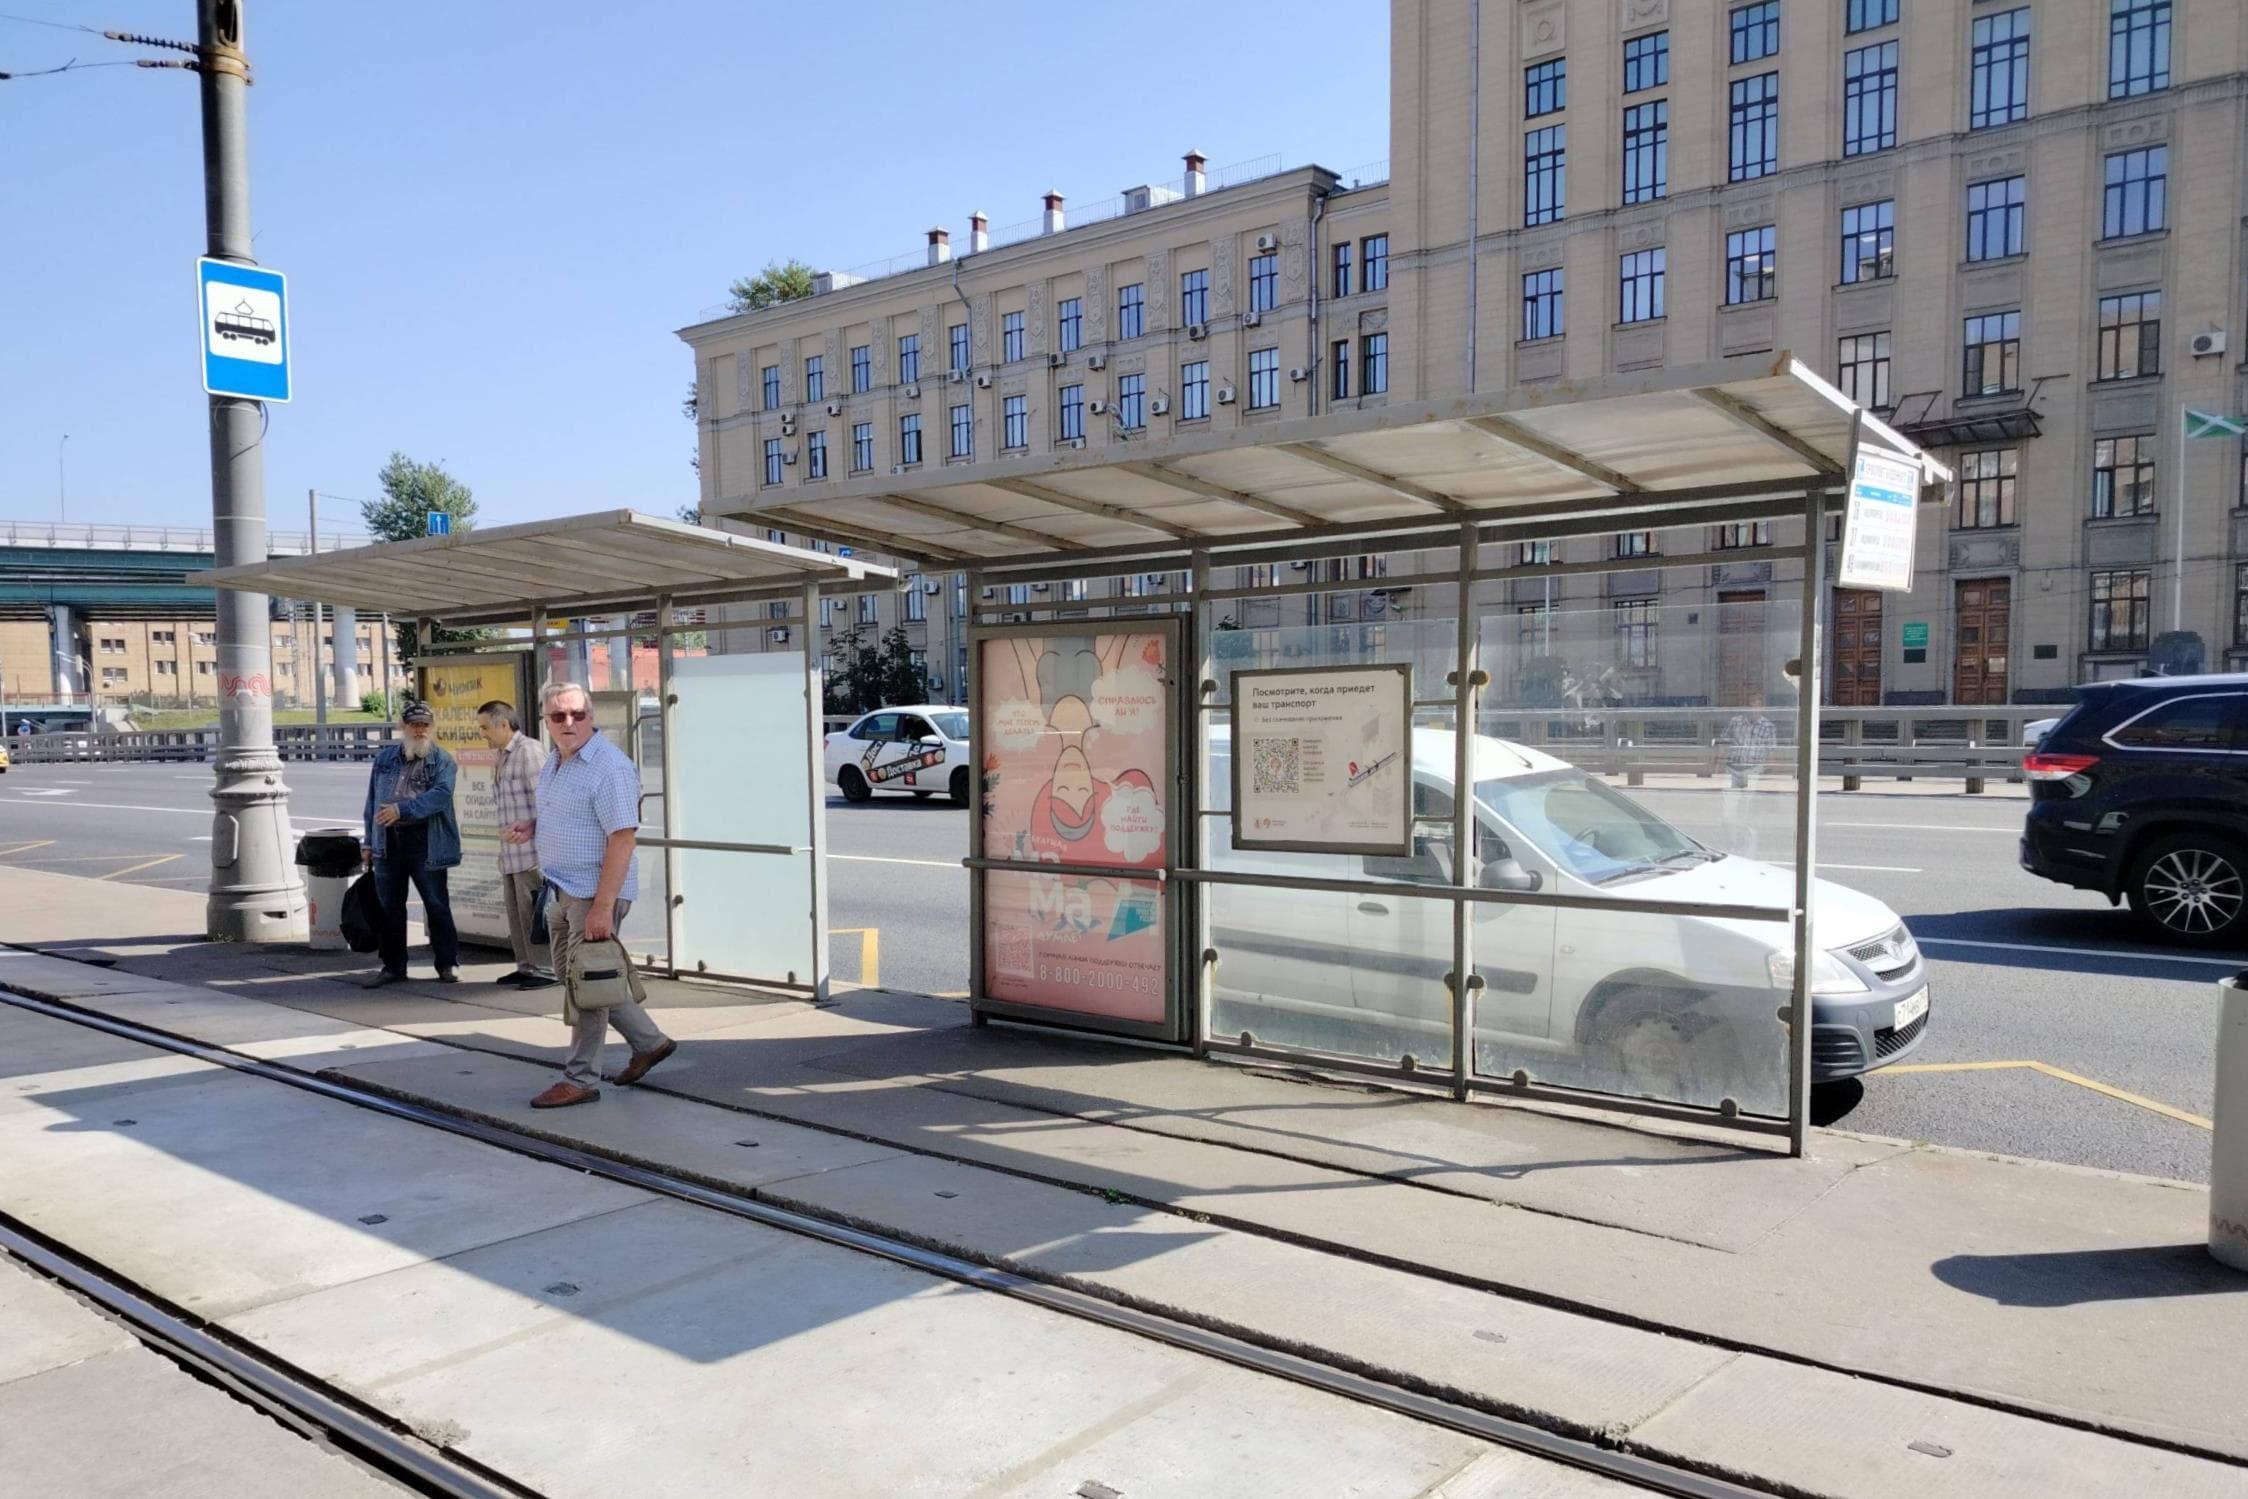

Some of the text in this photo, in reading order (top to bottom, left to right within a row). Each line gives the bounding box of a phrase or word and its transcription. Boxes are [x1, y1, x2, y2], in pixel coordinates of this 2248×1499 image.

[1252, 685, 1375, 697] Посмотрите, когда приедет
[1271, 700, 1316, 711] транспорт
[436, 726, 482, 744] СКИДОК
[472, 781, 486, 791] ВСЕ
[463, 809, 474, 819] НА
